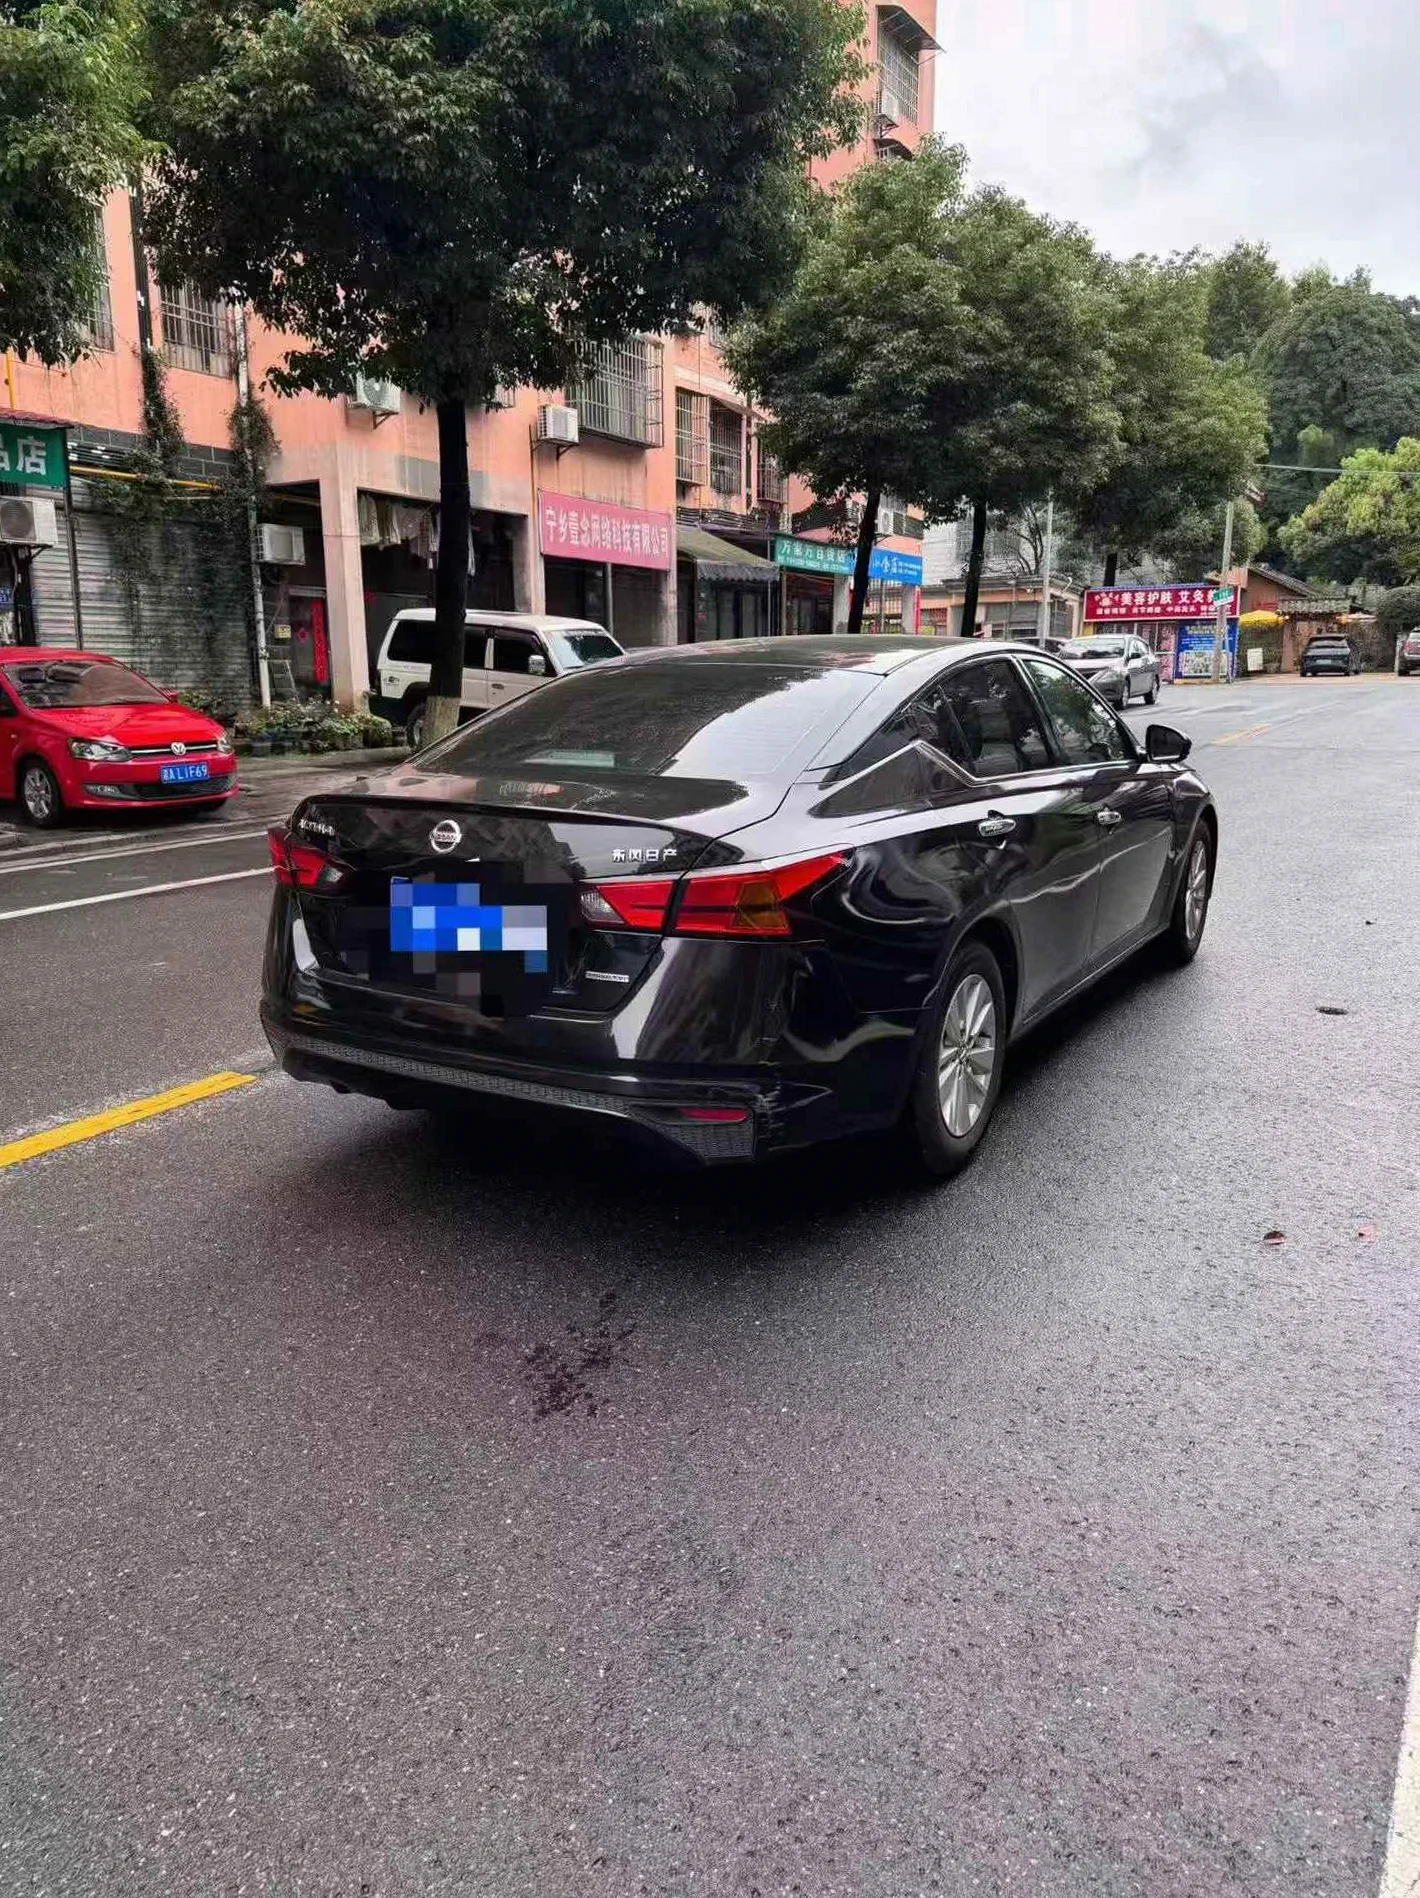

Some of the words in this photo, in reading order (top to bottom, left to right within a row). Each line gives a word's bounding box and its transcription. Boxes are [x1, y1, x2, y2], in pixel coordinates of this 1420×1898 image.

[1121, 590, 1173, 606] 美容护肤
[612, 848, 677, 863] 东风日产
